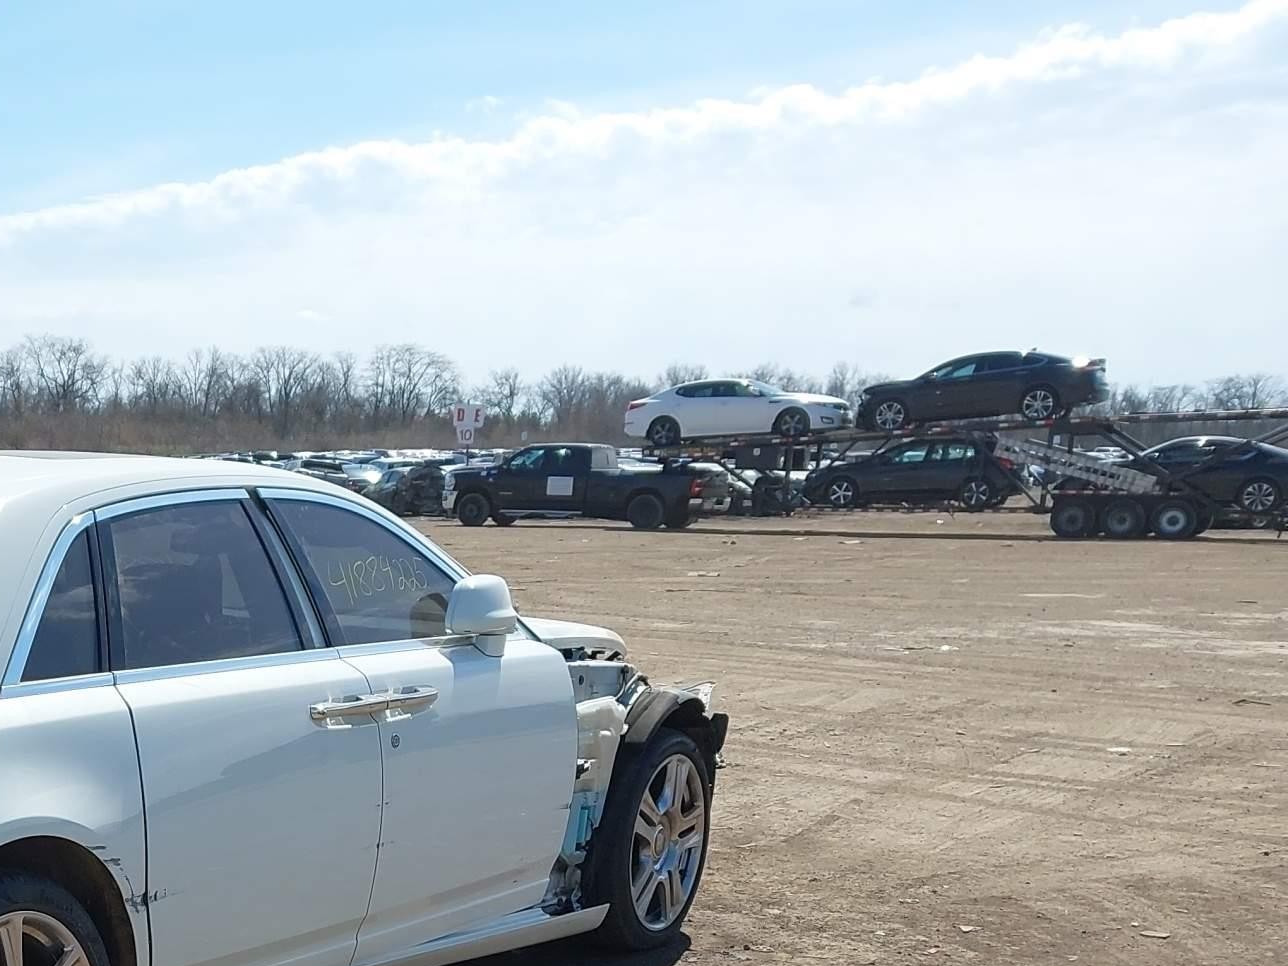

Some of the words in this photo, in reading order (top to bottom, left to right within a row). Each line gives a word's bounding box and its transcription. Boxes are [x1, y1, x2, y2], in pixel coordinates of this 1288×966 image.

[457, 407, 465, 422] D
[474, 408, 481, 423] E
[460, 428, 472, 441] 10
[327, 555, 428, 606] 41884225
